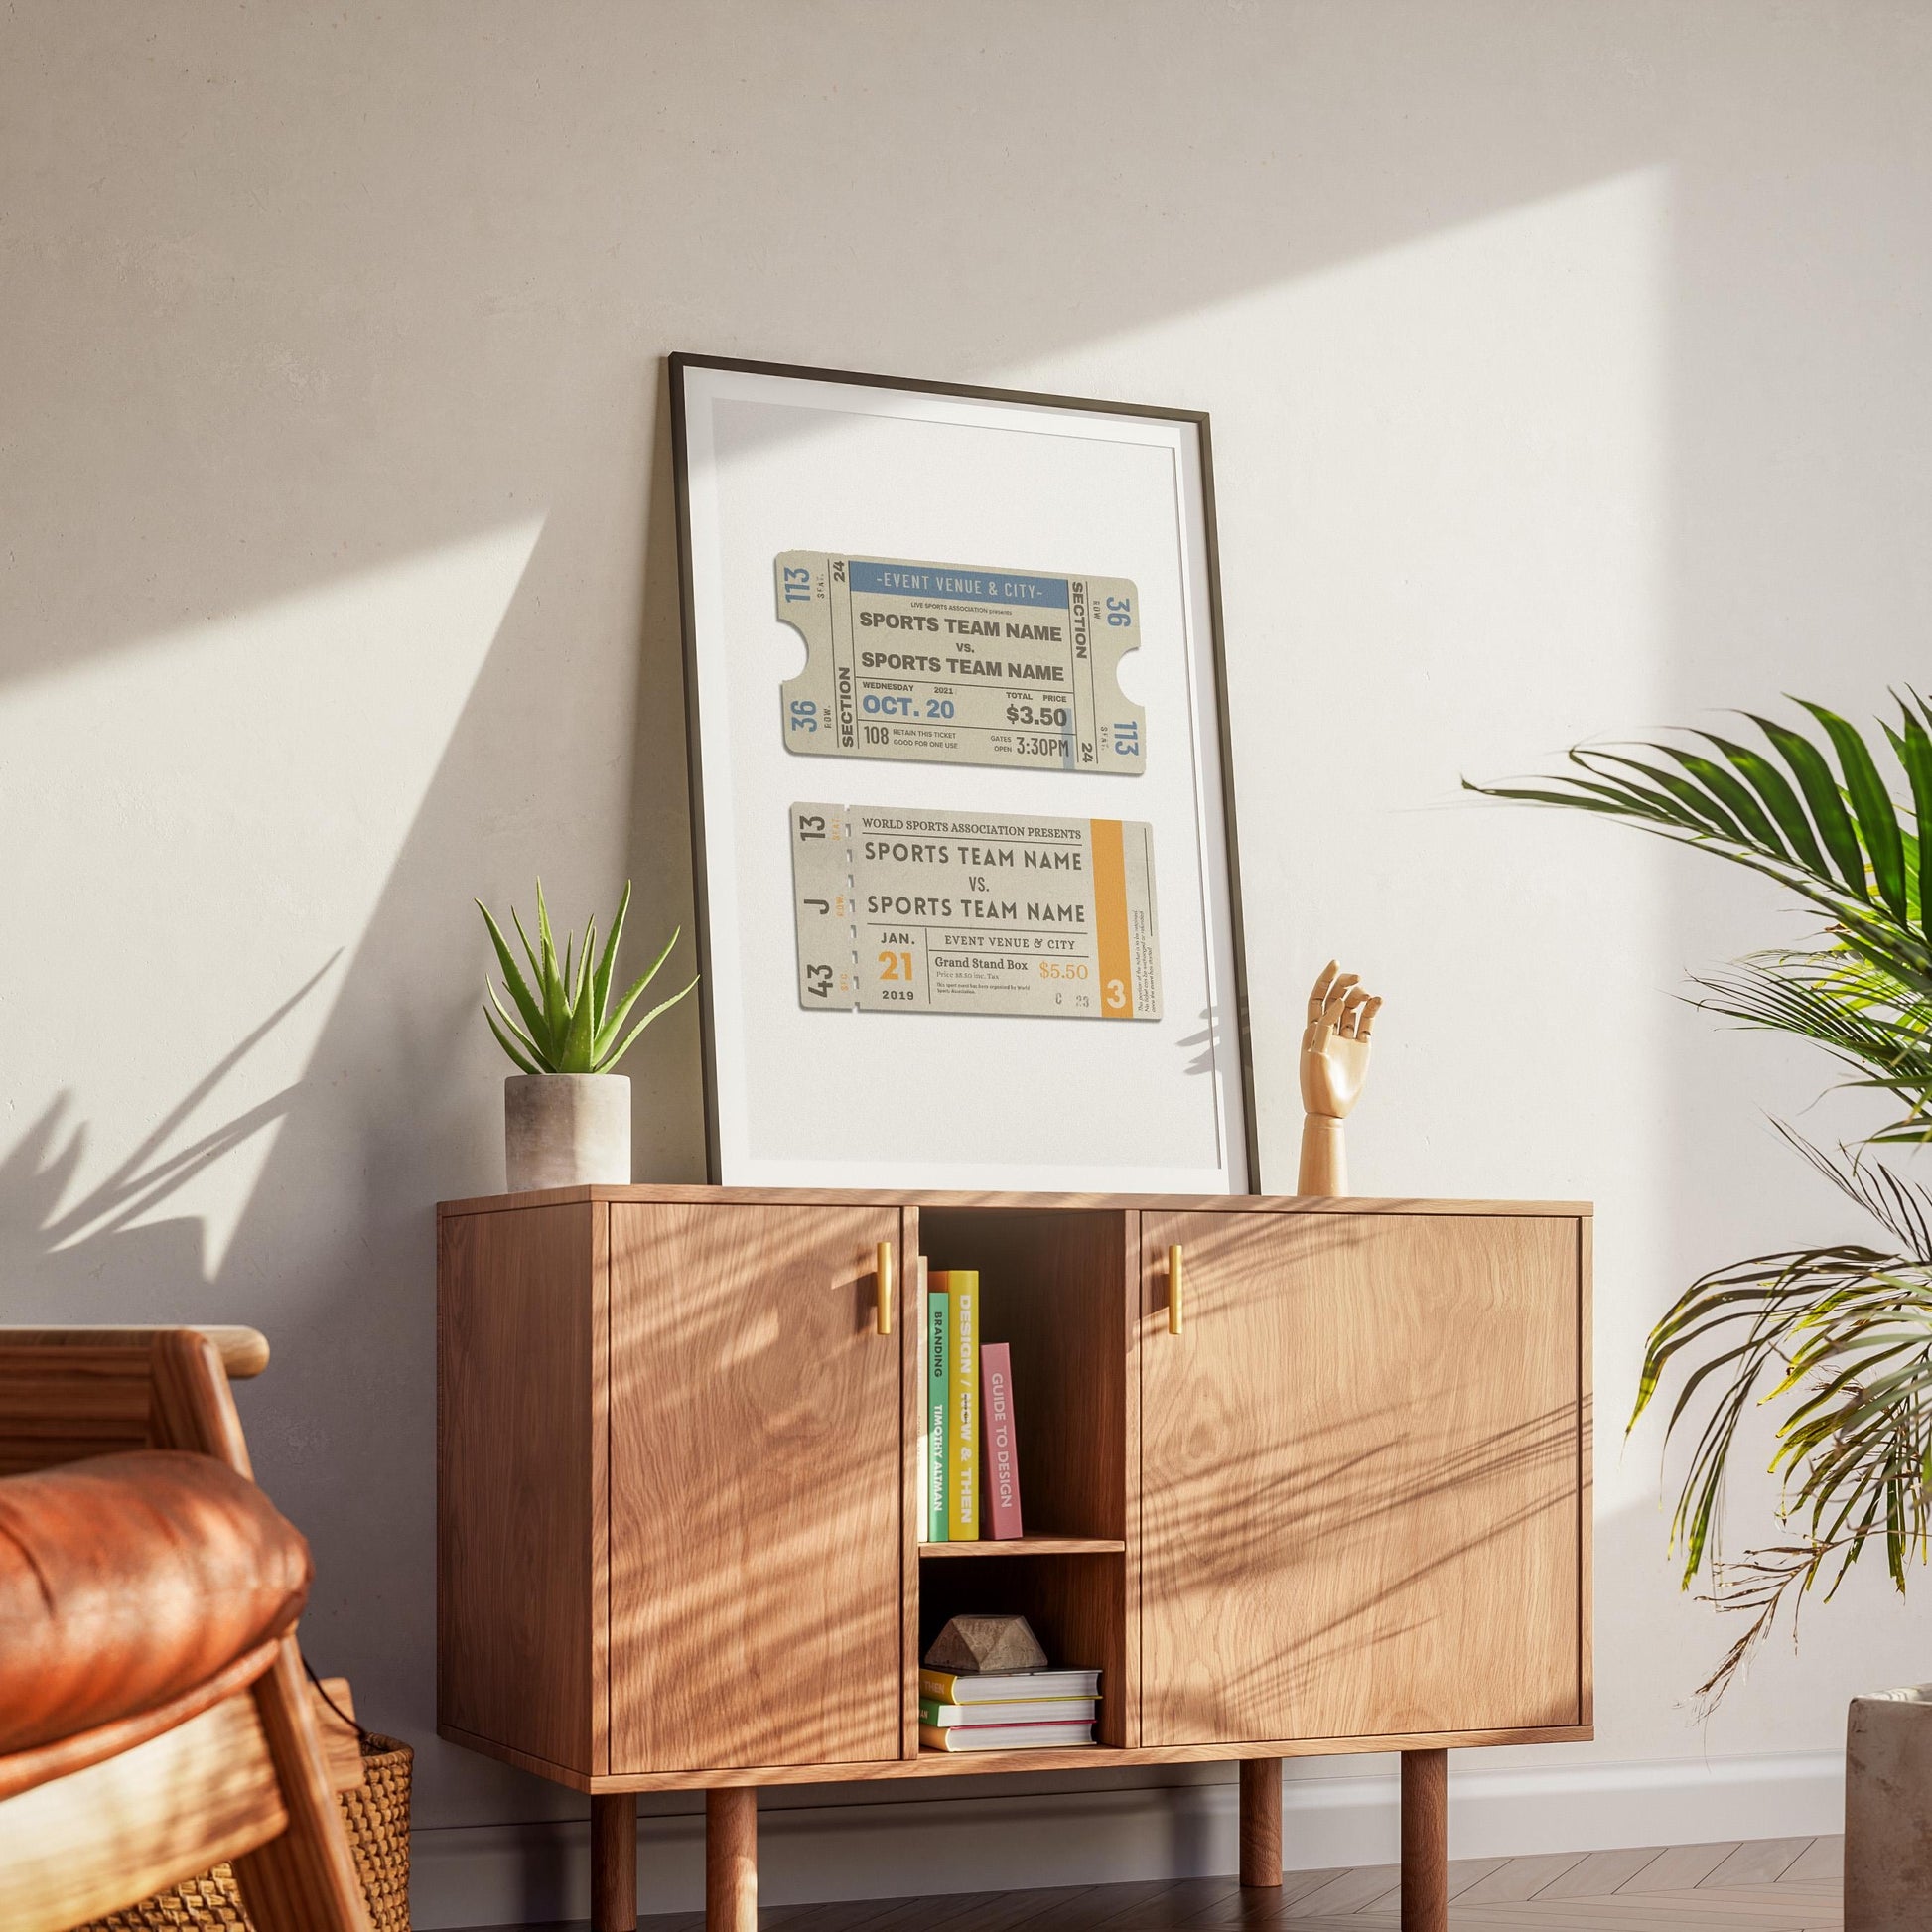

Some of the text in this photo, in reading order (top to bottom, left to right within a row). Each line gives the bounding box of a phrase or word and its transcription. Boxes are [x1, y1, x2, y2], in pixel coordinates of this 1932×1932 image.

[784, 567, 811, 603] 113
[936, 577, 982, 595] VENUE
[988, 581, 998, 596] &
[949, 605, 988, 614] ASSOCIATION
[1106, 597, 1131, 627] 36
[859, 612, 1063, 642] SPORTS TEAM NAME
[833, 561, 854, 748] SECTION 24
[956, 643, 975, 654] VS.
[861, 652, 1065, 682] SPORTS TEAM NAME
[1072, 581, 1094, 763] SECTION 24
[862, 682, 914, 692] WEDNESDAY
[1006, 691, 1033, 701] TOTAL
[790, 700, 818, 732] 36
[862, 695, 955, 719] OCT. 20
[1006, 703, 1068, 727] $3.50
[864, 726, 889, 745] 108
[893, 728, 917, 737] RETAIN
[934, 731, 956, 739] TICKET
[1114, 721, 1139, 756] 113
[1017, 736, 1070, 757] 3:30PM
[799, 815, 826, 841] 13
[862, 818, 1082, 839] WORLD SPORTS ASSOCIATION PRESENTS
[865, 842, 1082, 870] SPORTS TEAM NAME
[968, 876, 990, 892] VS.
[804, 899, 830, 915] J
[868, 895, 1085, 923] SPORTS TEAM NAME
[881, 933, 915, 945] JAN.
[945, 935, 1076, 950] EVENT VENUE & CITY
[878, 951, 913, 981] 21
[935, 957, 1028, 970] Grand Stand Box
[1039, 961, 1089, 980] $5.50
[807, 964, 833, 998] 43
[882, 990, 914, 1000] 2019
[1106, 979, 1126, 1009] 3
[960, 1294, 971, 1374] DESIGN
[934, 1404, 943, 1459] TIMOTHY
[992, 1373, 1012, 1508] GUIDE TO DESIGN
[961, 1447, 972, 1461] &
[934, 1461, 943, 1512] ALTMAN
[961, 1468, 972, 1523] THEN
[924, 1681, 944, 1694] THEN
